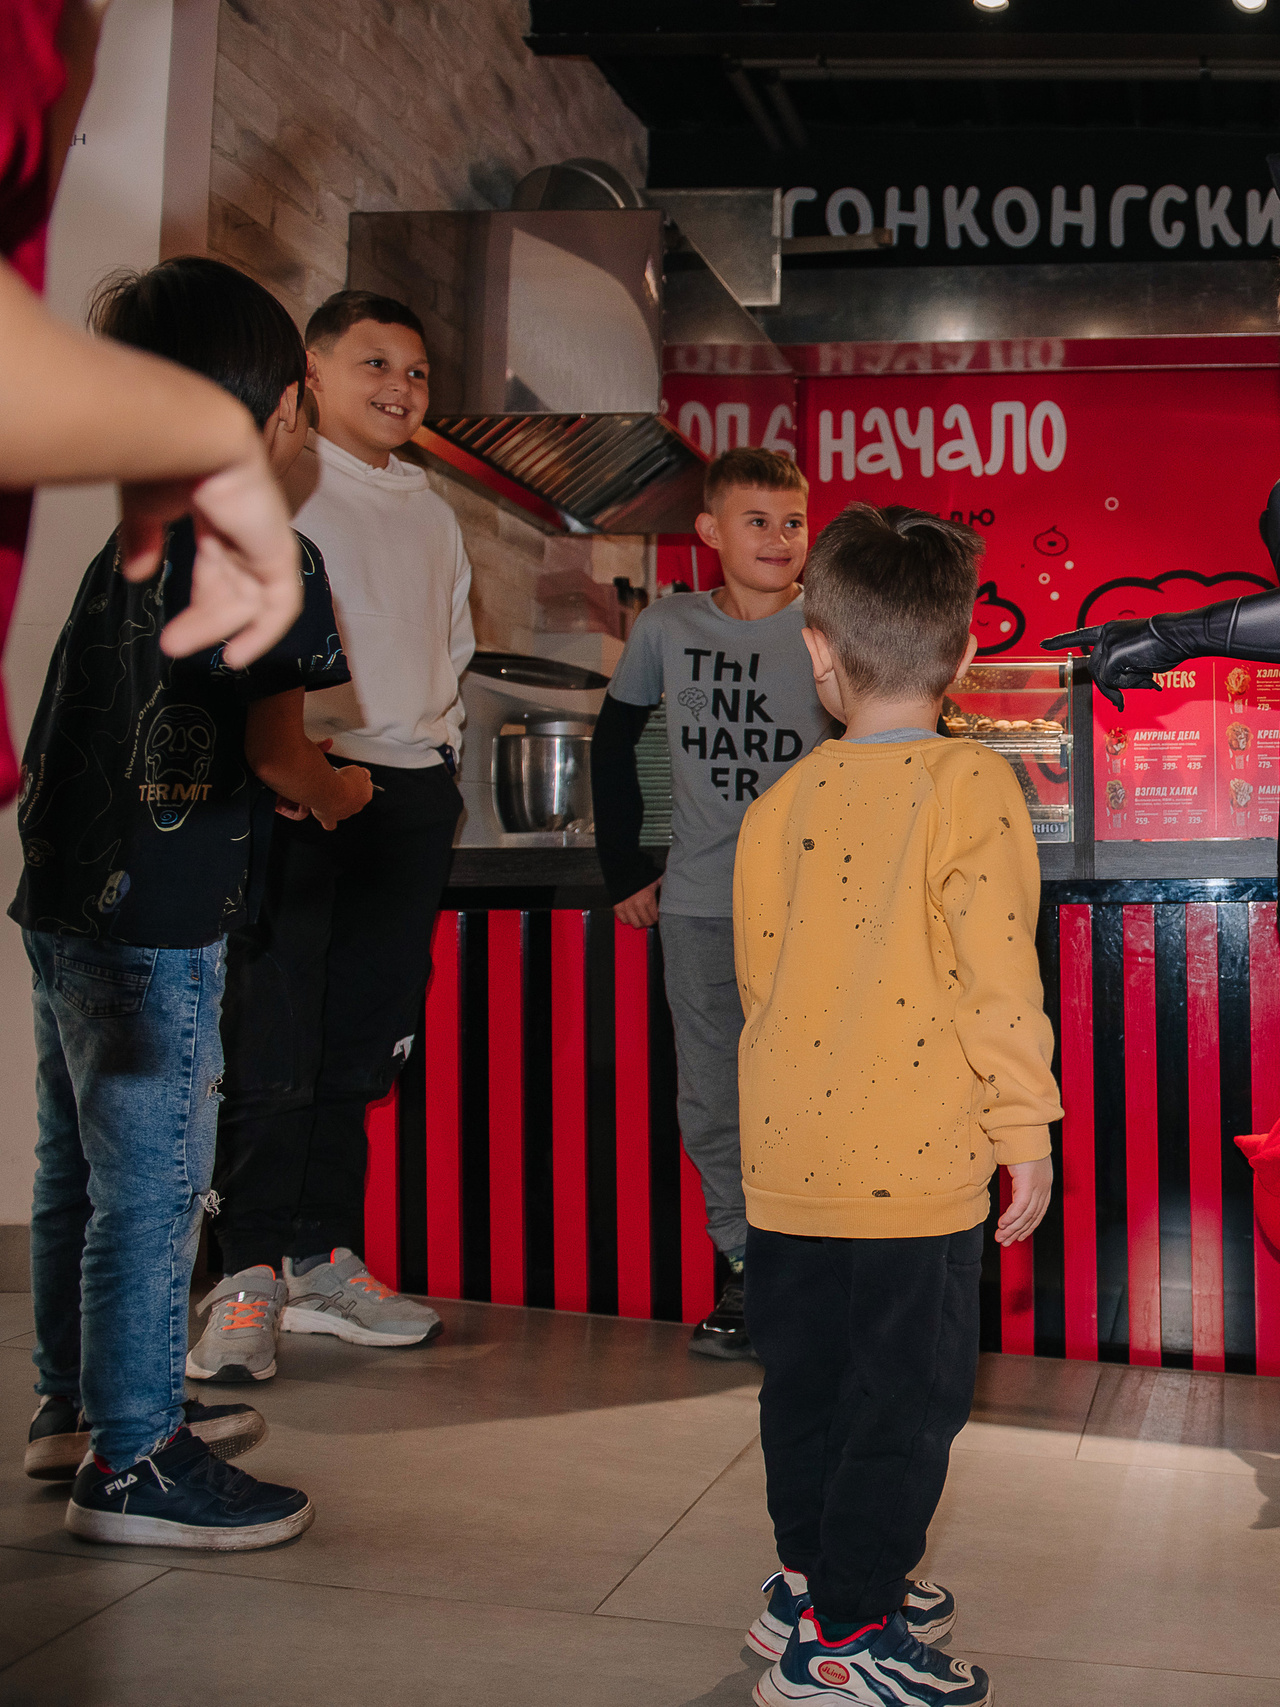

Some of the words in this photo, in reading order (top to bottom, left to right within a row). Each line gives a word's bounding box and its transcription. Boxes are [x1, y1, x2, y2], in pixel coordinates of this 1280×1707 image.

[818, 400, 1067, 482] НАЧАЛО
[711, 688, 774, 723] NK
[682, 726, 803, 763] HARD
[1133, 731, 1177, 741] АМУРНЫЕ
[1177, 730, 1200, 741] ДЕЛА
[1257, 729, 1280, 739] КРЕП
[1135, 787, 1168, 797] ВЗГЛЯД
[1169, 786, 1198, 796] ХАЛКА
[104, 1473, 138, 1496] FILA
